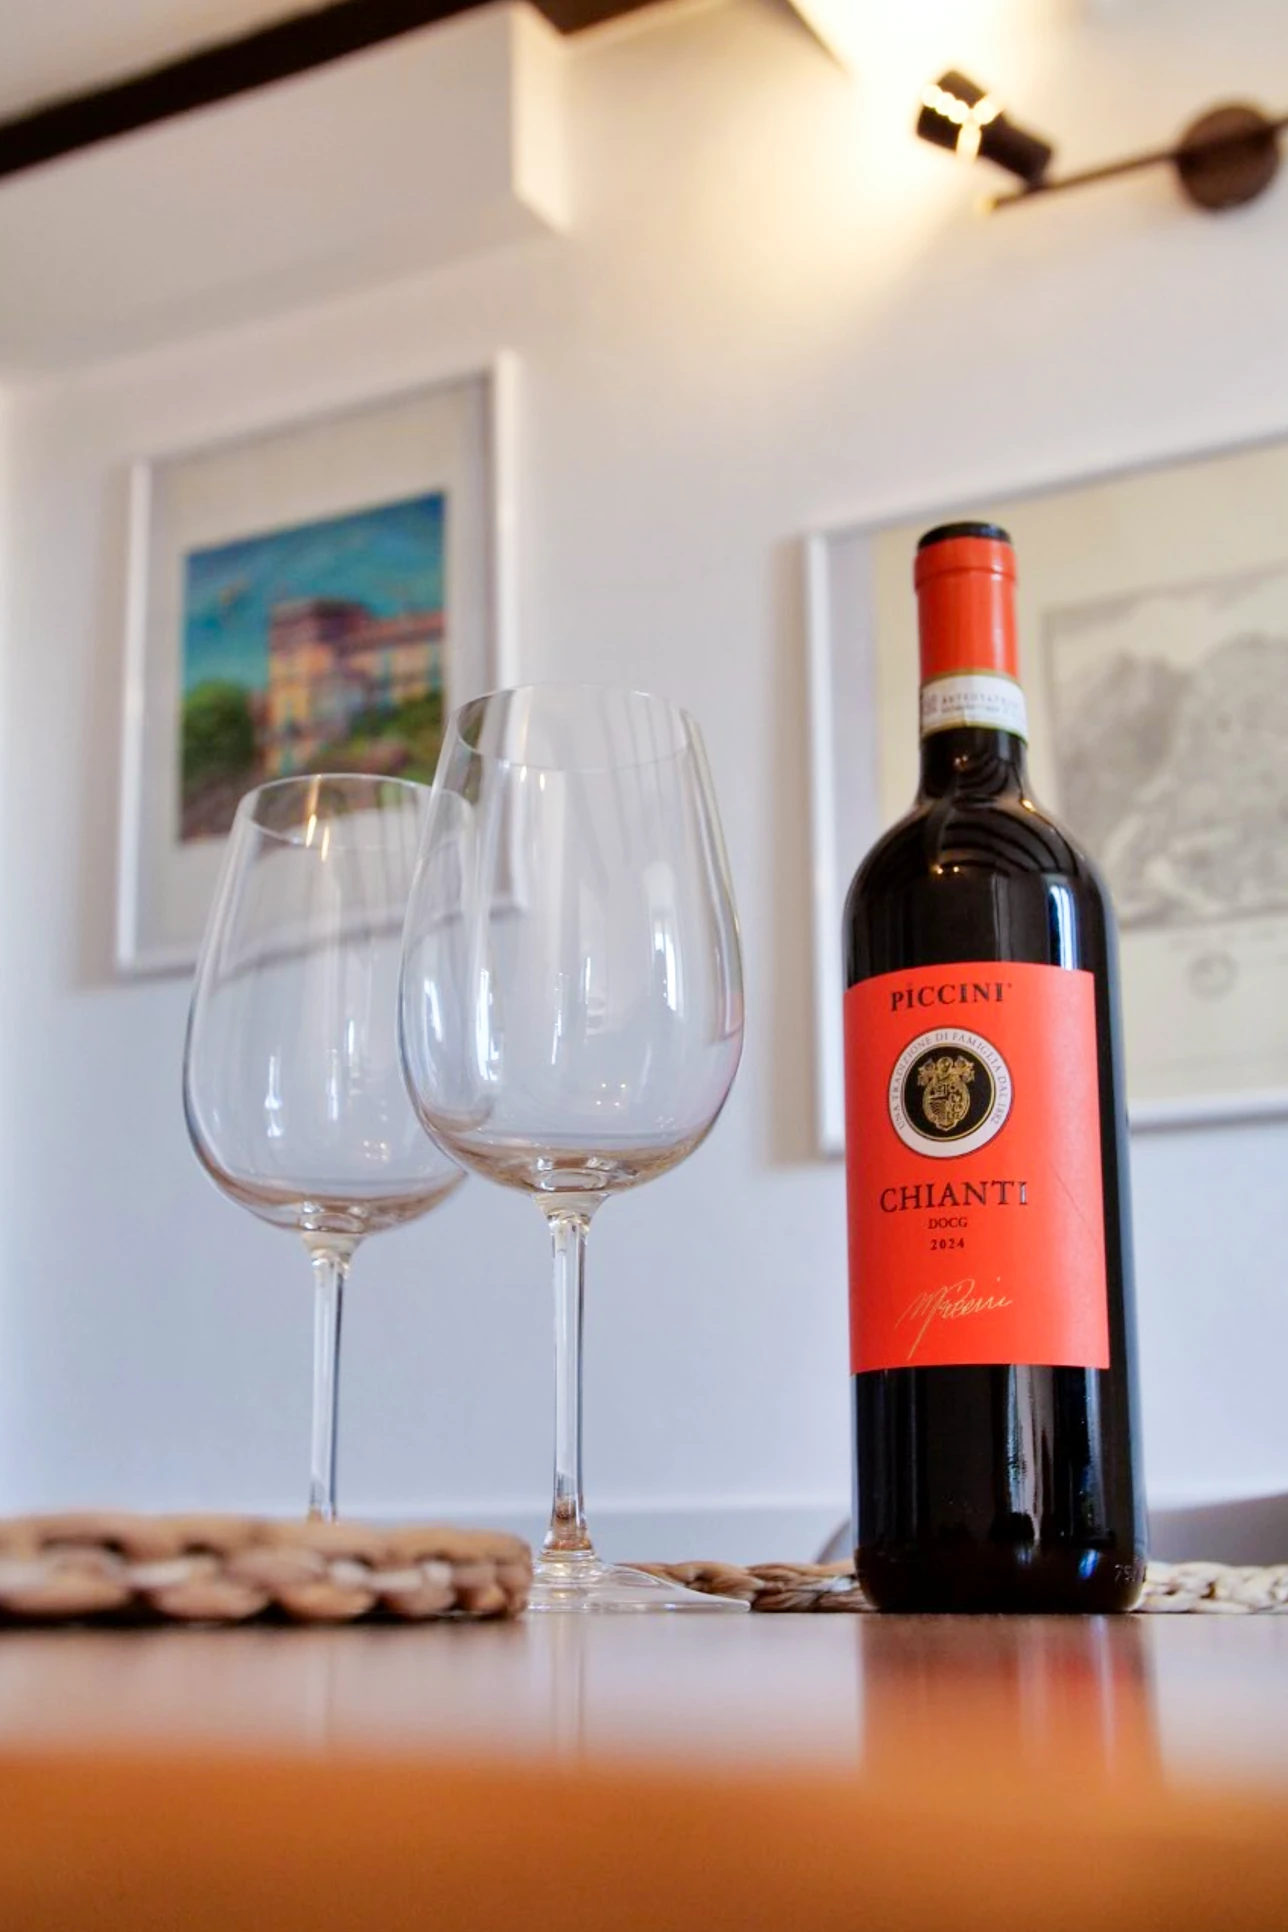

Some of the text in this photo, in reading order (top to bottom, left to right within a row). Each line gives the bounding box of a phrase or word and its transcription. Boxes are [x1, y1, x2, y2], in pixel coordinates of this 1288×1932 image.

[890, 982, 1003, 1012] PICCINI
[935, 1031, 948, 1041] DI
[952, 1031, 1002, 1073] FAMIGLIA
[997, 1075, 1008, 1099] DAL
[880, 1180, 1028, 1213] CHIANTI
[928, 1217, 968, 1229] DOCG
[930, 1238, 965, 1250] 2024
